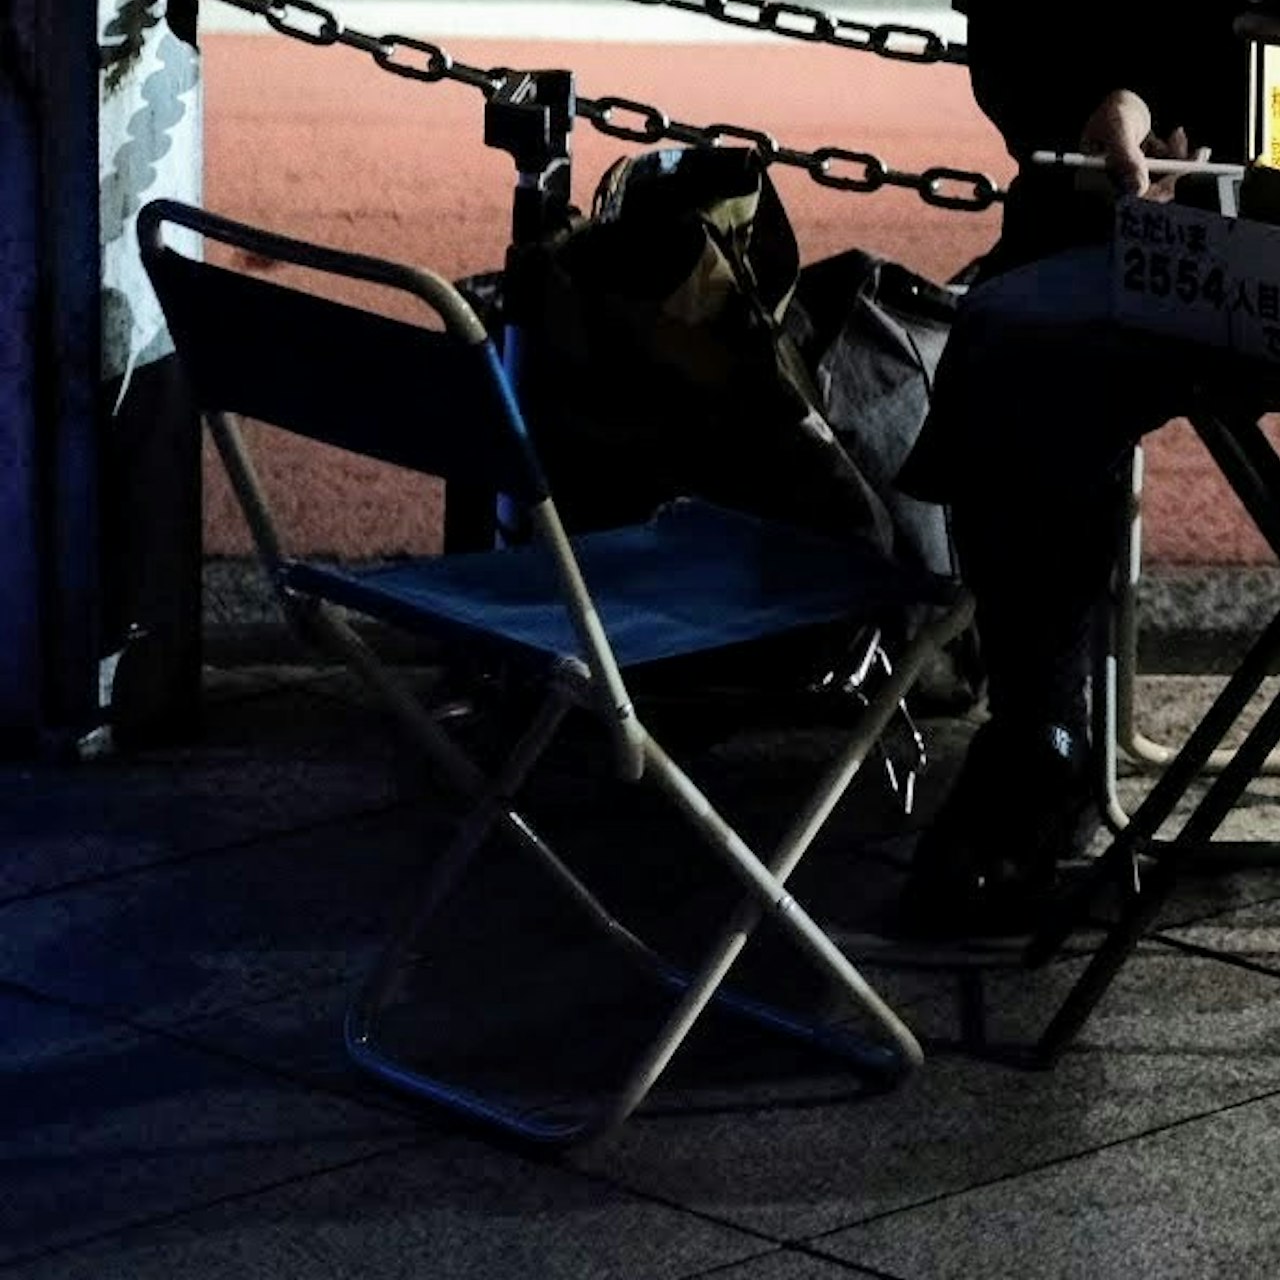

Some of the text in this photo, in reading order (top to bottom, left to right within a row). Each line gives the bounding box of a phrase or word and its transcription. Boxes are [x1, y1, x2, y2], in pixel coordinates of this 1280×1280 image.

[1120, 209, 1207, 253] ただいま
[1123, 246, 1280, 322] 2554人目
